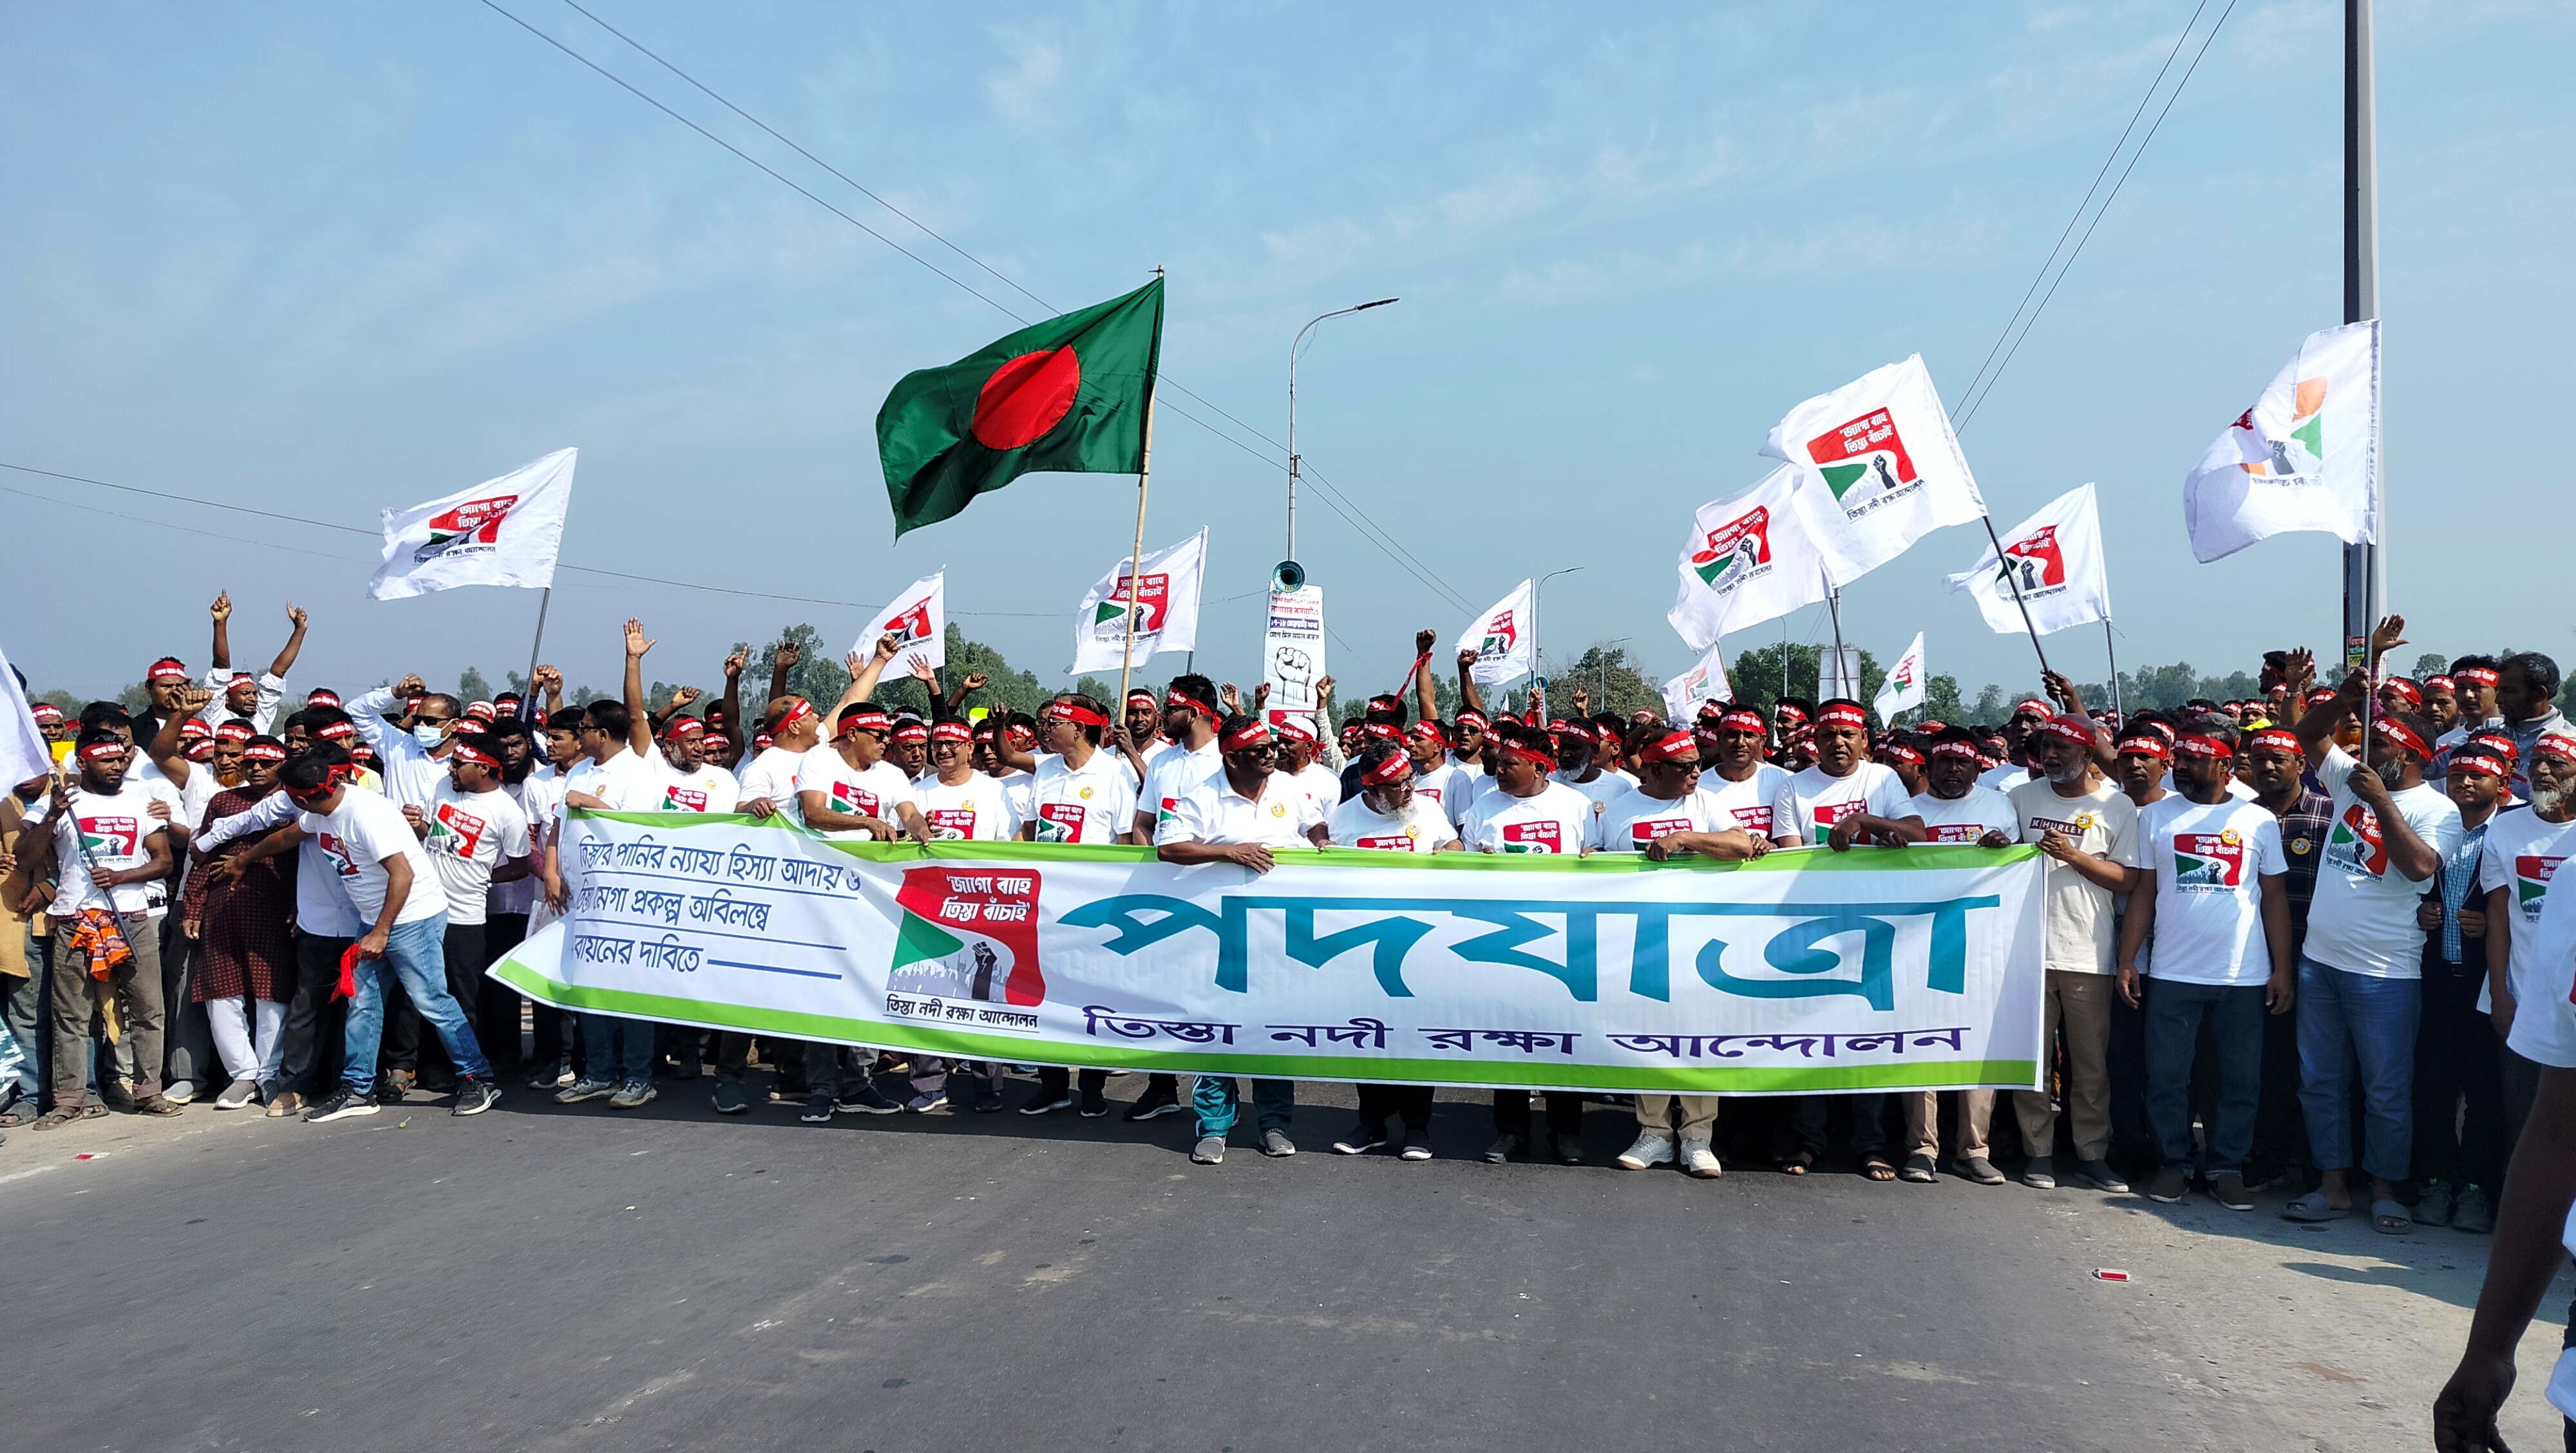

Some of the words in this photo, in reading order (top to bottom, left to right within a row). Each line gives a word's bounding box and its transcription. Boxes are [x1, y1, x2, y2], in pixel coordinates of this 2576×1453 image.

[616, 834, 667, 870] পানির
[726, 843, 777, 881] হিস্যা
[781, 858, 844, 892] আদায়
[846, 870, 862, 891] ও
[996, 877, 1032, 895] বাহে
[630, 889, 685, 926] প্রকল্প
[688, 888, 772, 932] অবিলম্বে
[939, 896, 981, 922] তিস্তা
[639, 933, 705, 973] দাবিতে
[1056, 893, 2000, 1012] পদযাত্রা
[886, 993, 916, 1016] তিস্তা
[918, 998, 943, 1018] নদী
[946, 1005, 976, 1021] রক্ষা
[978, 1008, 1038, 1028] আন্দোলন
[1083, 1005, 1243, 1045] তিস্তা
[1264, 1017, 1395, 1050] নদী
[1417, 1027, 1583, 1056] রক্ষা
[1605, 1027, 1972, 1058] আন্দোলন
